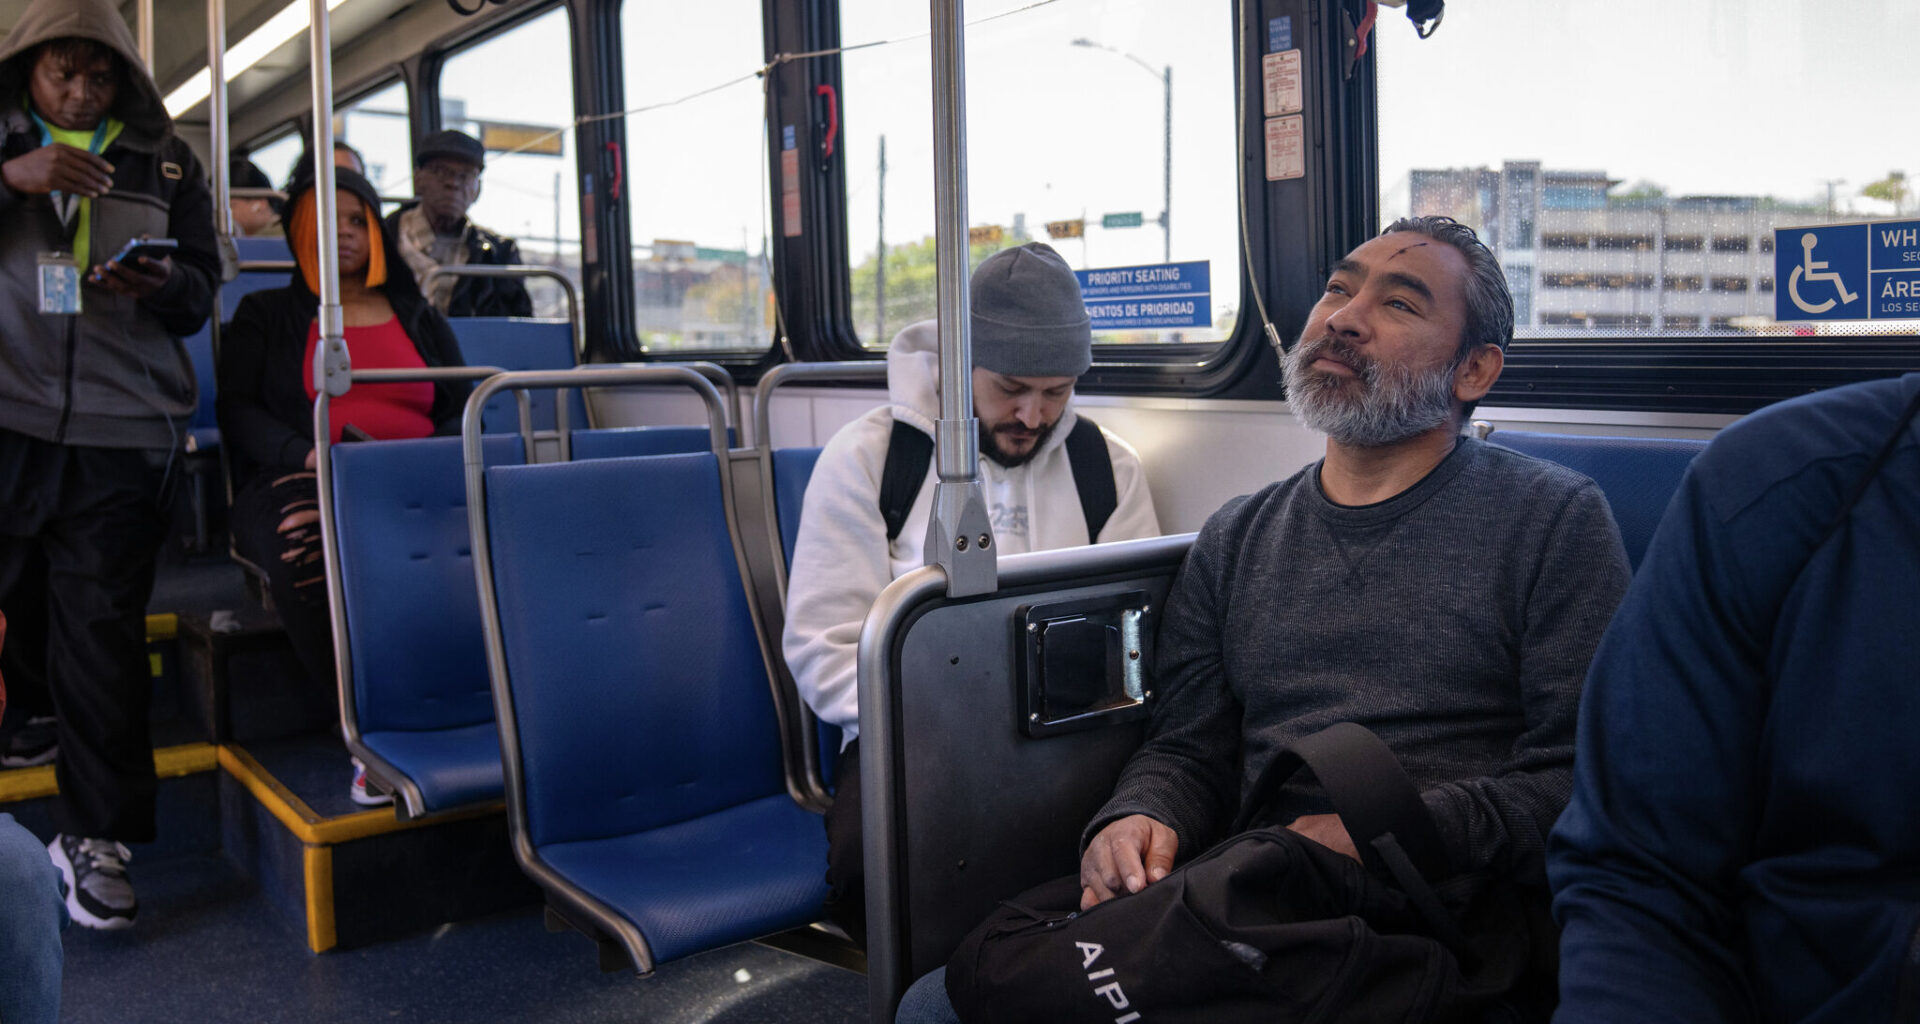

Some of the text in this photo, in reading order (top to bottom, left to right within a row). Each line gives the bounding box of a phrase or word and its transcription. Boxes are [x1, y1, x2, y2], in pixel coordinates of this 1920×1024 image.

[1088, 267, 1180, 286] PRIORITY SEATING
[1125, 303, 1139, 317] DE
[1140, 301, 1194, 316] PRIORIDAD
[1881, 302, 1920, 313] LOS SE
